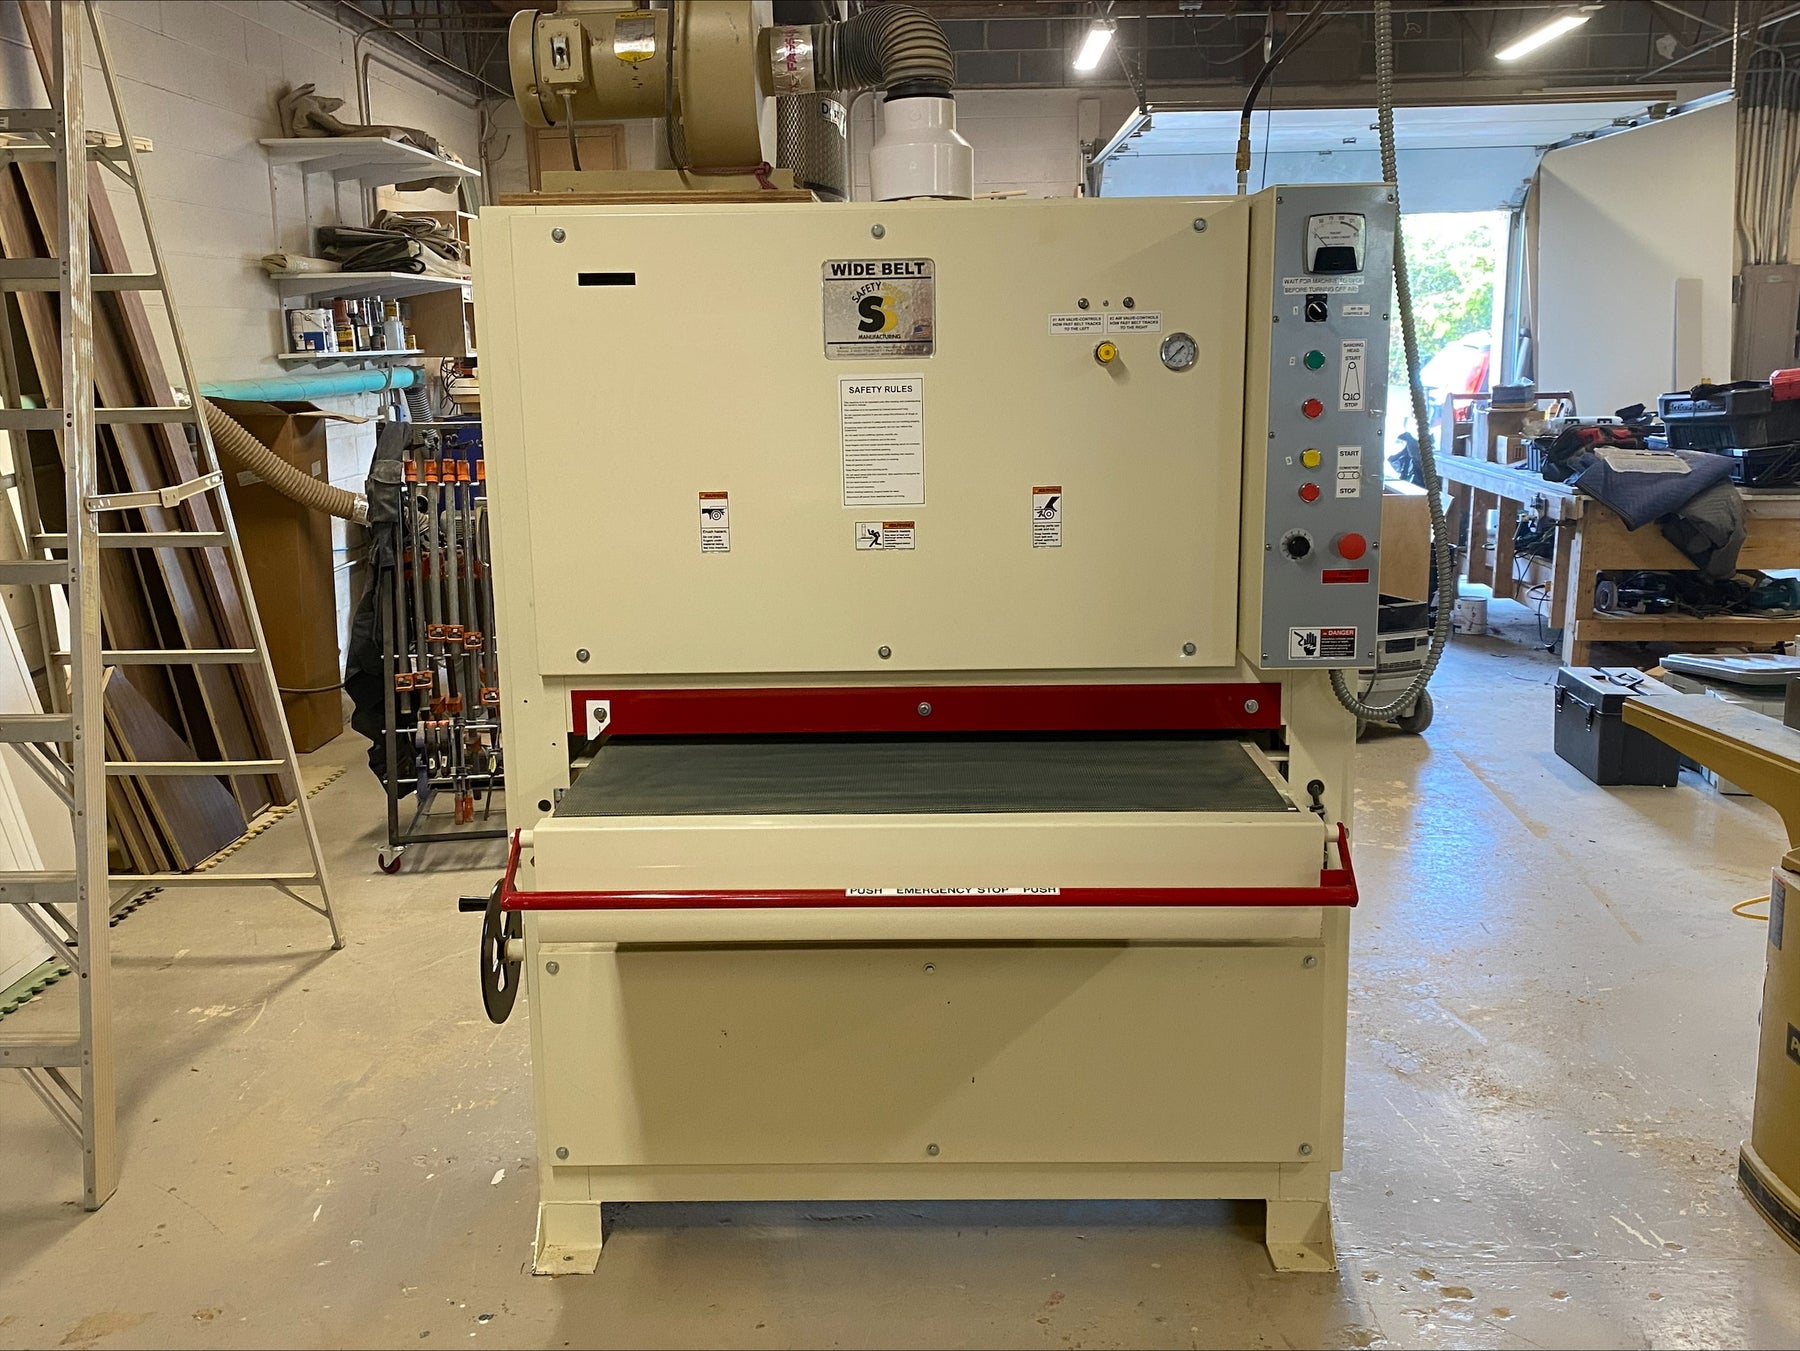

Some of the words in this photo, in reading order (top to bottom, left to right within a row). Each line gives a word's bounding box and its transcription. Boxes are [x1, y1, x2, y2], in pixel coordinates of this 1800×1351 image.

[831, 264, 876, 276] WIDE
[882, 263, 925, 274] BELT
[852, 281, 882, 303] SAFETY
